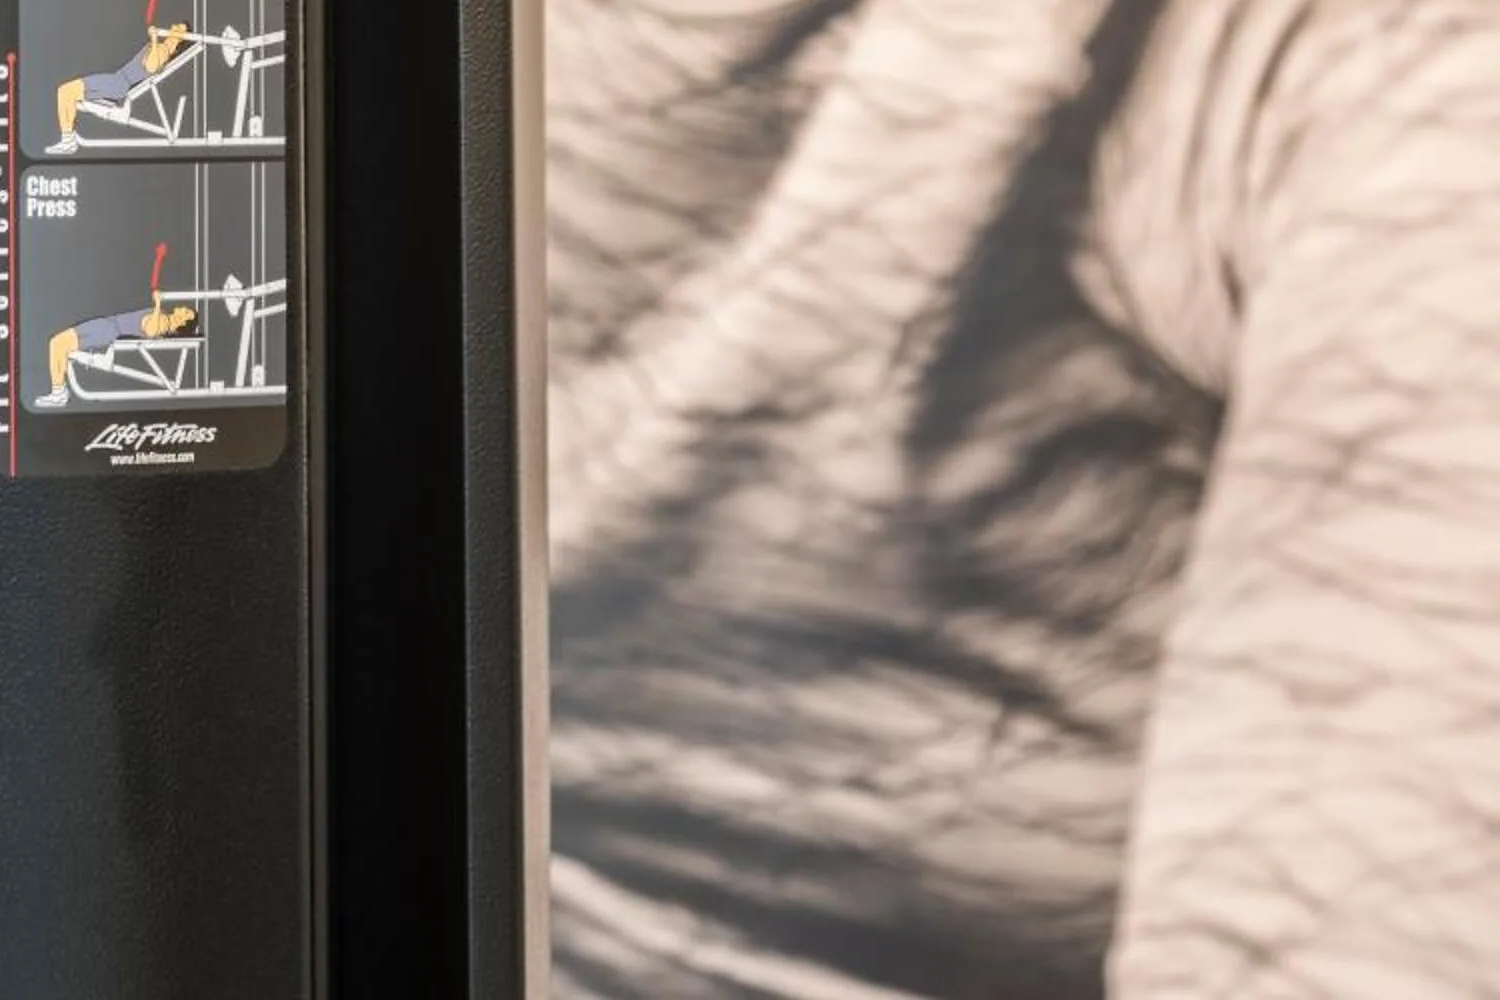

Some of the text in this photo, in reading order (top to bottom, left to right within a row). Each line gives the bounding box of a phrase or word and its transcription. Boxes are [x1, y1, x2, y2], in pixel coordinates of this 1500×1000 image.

[25, 174, 79, 198] Chest
[25, 196, 78, 218] Press
[109, 451, 196, 467] www.lifefitness.com
